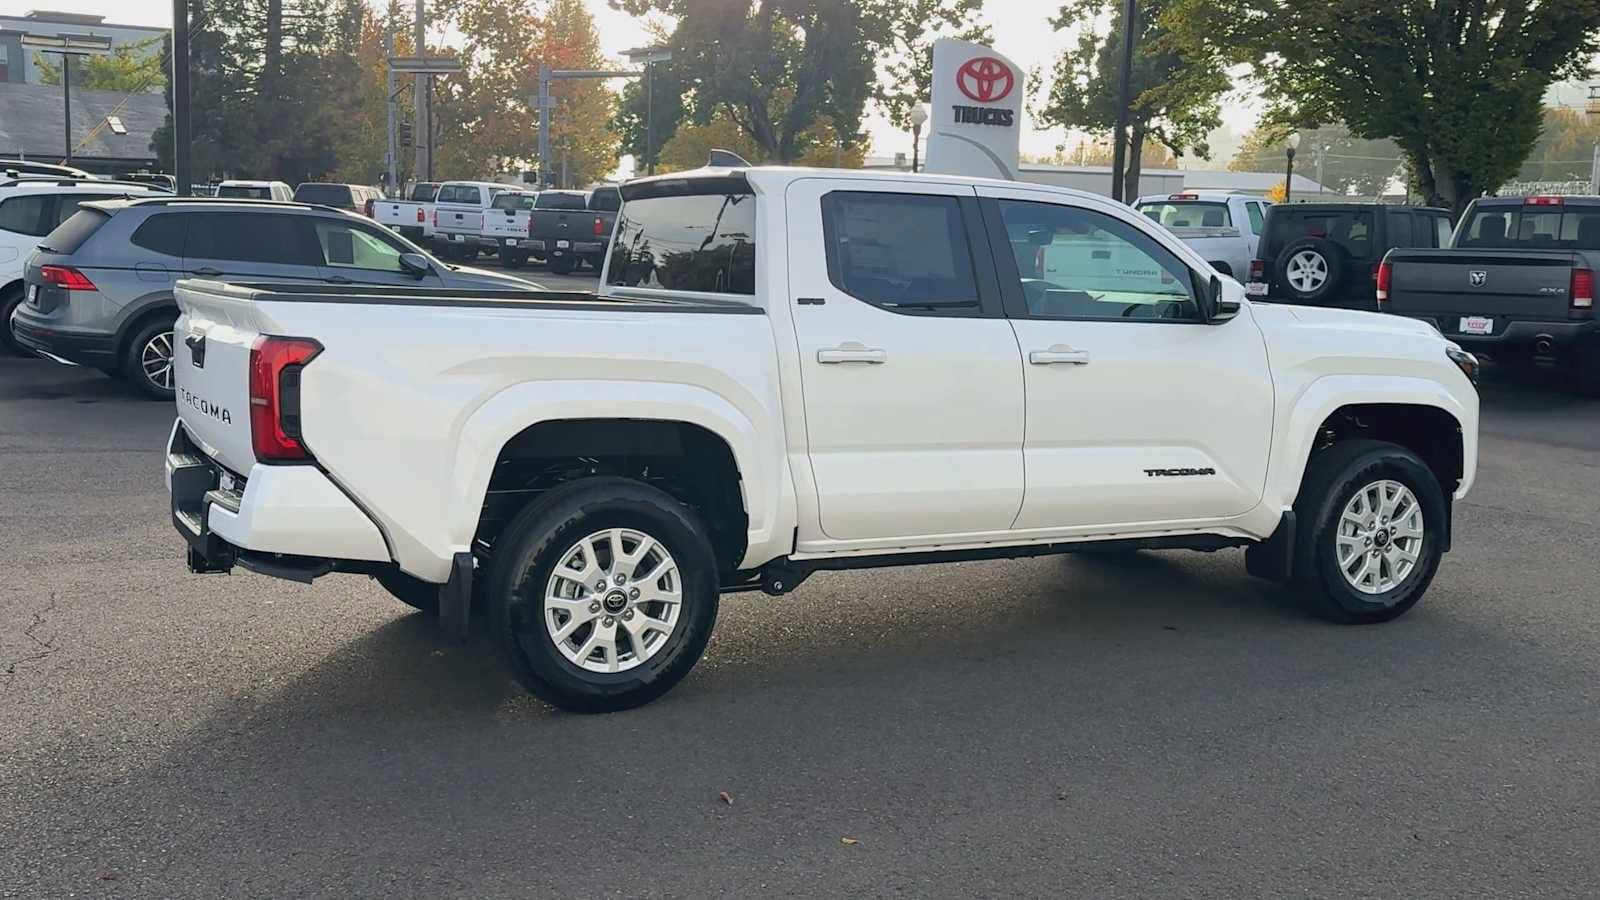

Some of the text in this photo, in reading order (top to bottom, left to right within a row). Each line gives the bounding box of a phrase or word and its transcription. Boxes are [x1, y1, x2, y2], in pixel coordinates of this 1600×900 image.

[952, 105, 1014, 127] TRUCKS
[179, 387, 232, 425] TACOMA
[1143, 467, 1216, 477] TACOMA
